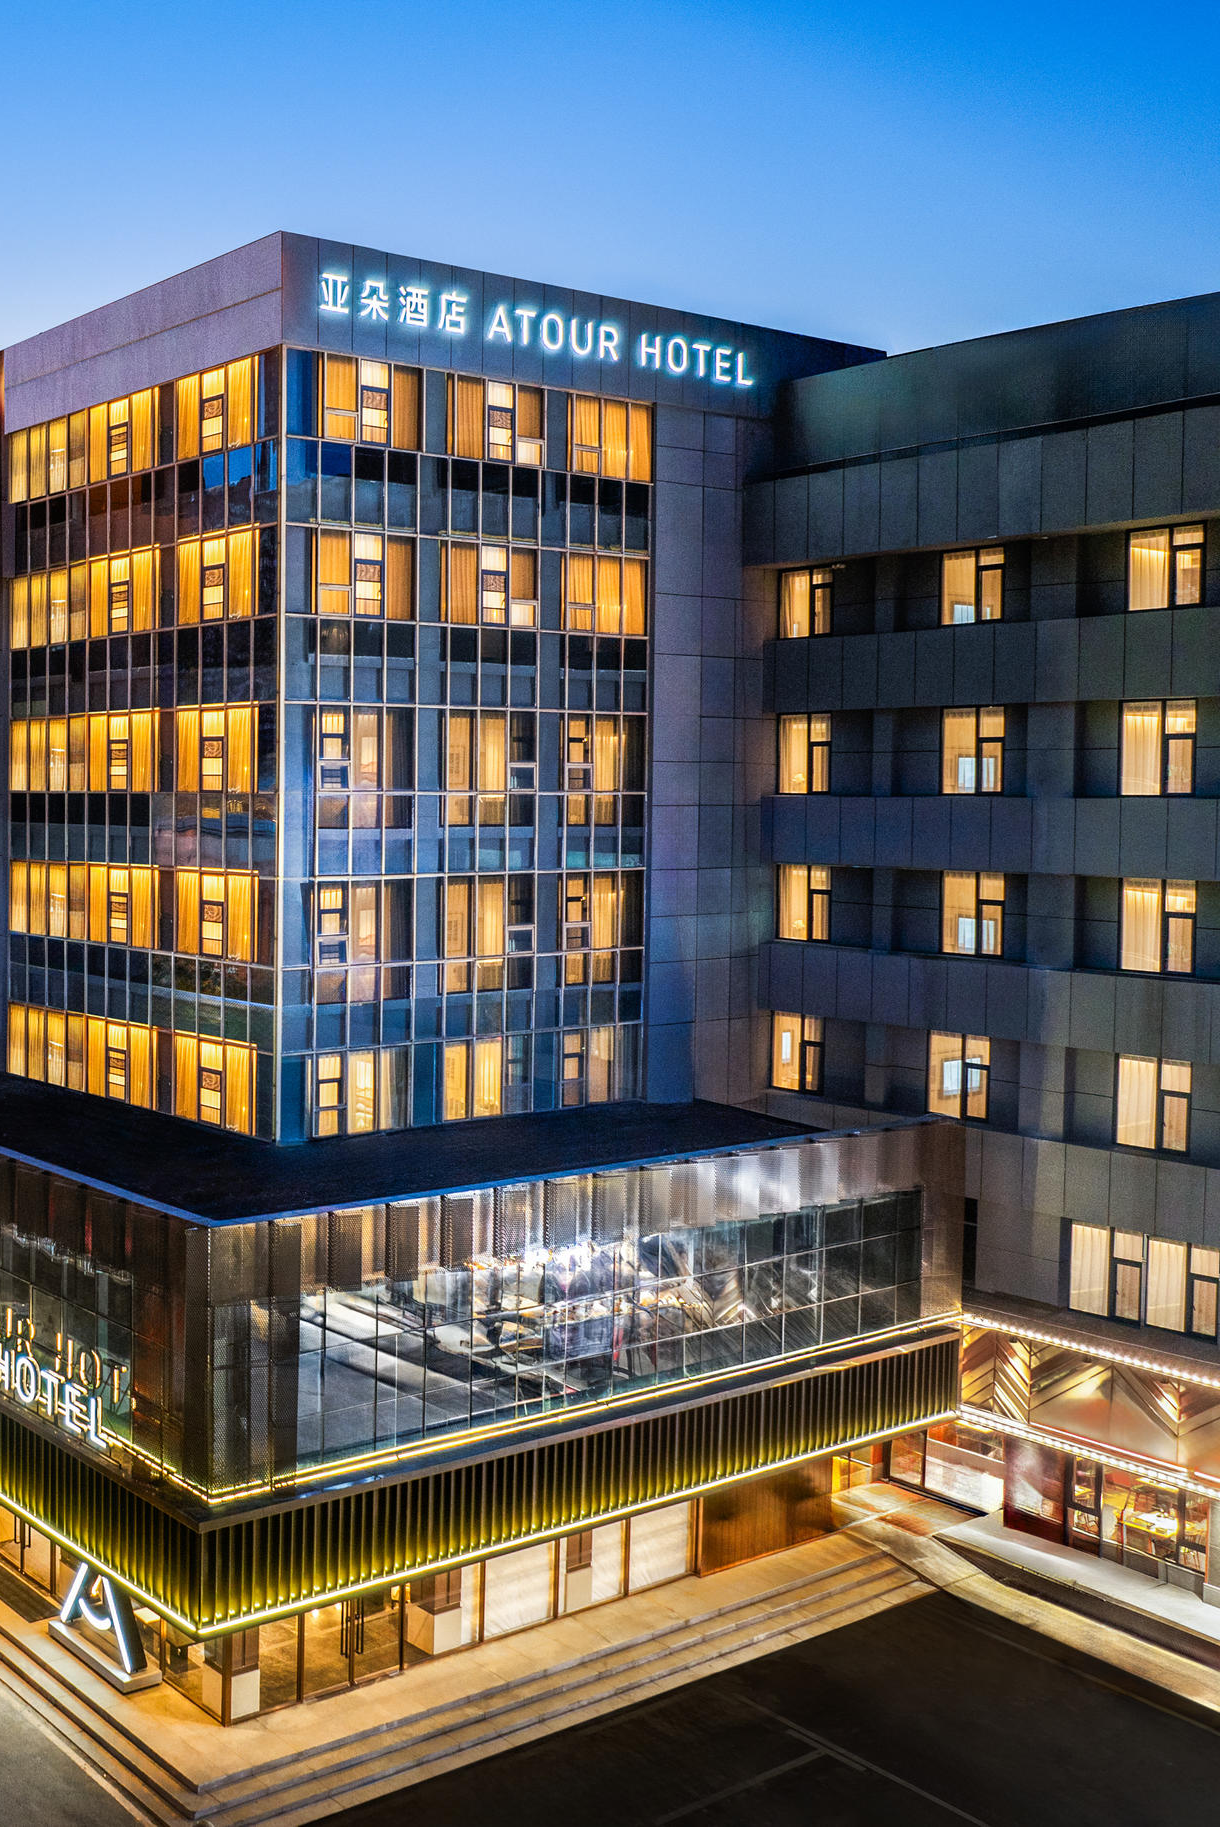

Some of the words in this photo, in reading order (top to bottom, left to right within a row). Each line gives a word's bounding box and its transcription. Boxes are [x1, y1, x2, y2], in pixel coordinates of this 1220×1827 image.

[320, 273, 468, 335] 亚朵酒店
[487, 305, 619, 362] ATOUR
[641, 335, 754, 387] HOTEL
